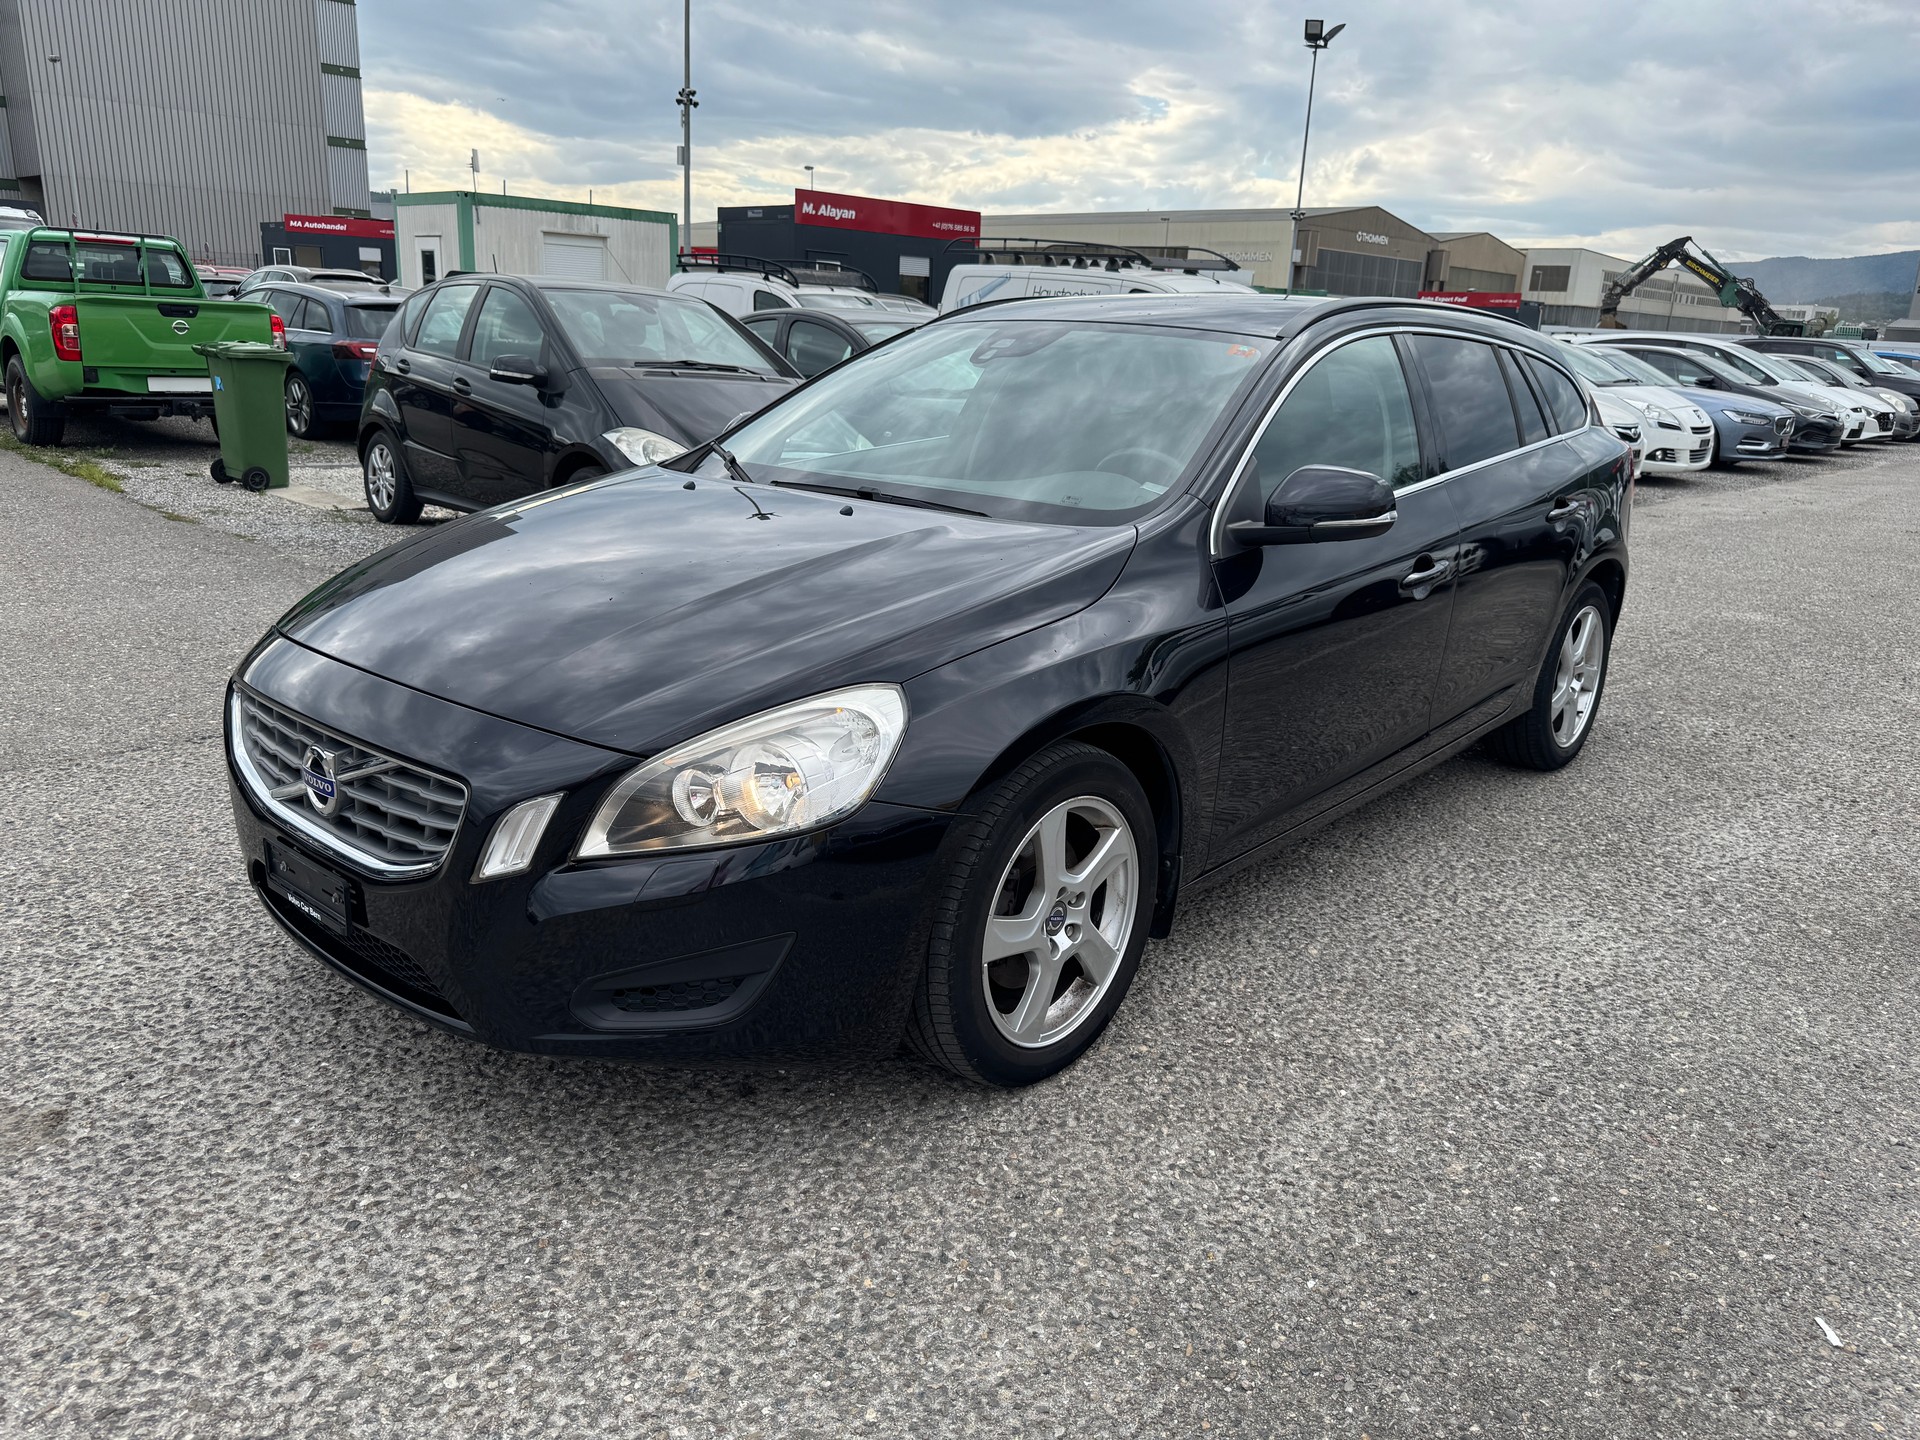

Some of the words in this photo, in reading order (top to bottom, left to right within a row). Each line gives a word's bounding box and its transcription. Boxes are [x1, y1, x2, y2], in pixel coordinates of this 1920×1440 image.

[802, 202, 815, 215] M.
[818, 204, 856, 220] Alayan
[289, 220, 303, 228] MA
[304, 221, 347, 231] Autohandel
[1361, 232, 1389, 245] THOMMEN
[304, 771, 332, 793] VOLVO
[300, 901, 309, 913] Car
[309, 906, 322, 921] Bern
